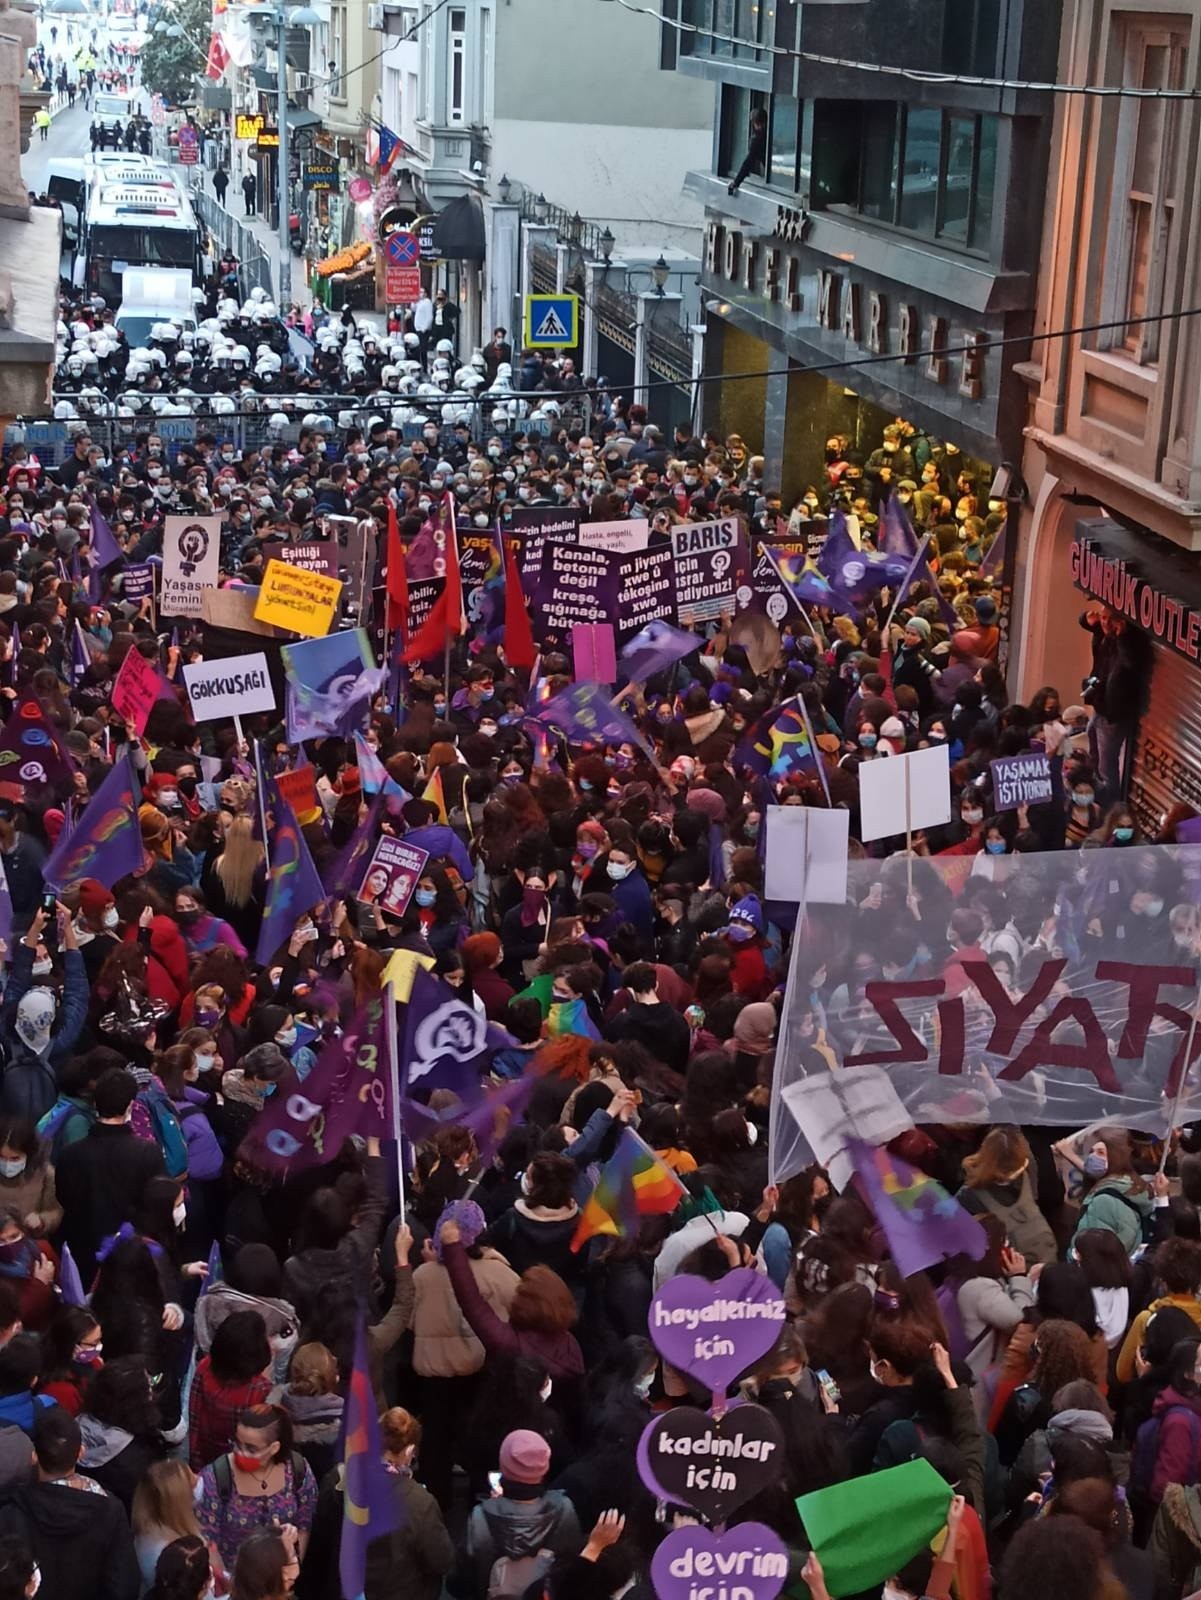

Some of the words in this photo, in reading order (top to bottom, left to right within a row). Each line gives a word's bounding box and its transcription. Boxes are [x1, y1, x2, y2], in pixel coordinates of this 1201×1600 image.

[705, 222, 804, 312] HOTEL
[541, 520, 575, 533] bedelini
[676, 522, 733, 554] BARIŞ
[281, 547, 320, 560] Eşitliği
[296, 560, 328, 570] sayan
[553, 547, 610, 565] Kanala,
[635, 551, 671, 573] jiyana
[553, 560, 607, 576] betona
[624, 572, 650, 587] xwe
[653, 565, 661, 578] û
[559, 573, 598, 588] değil
[617, 579, 670, 603] têkoşina
[676, 577, 732, 602] ediyoruz!
[553, 588, 600, 605] kreşe,
[632, 597, 657, 613] xwe
[1070, 537, 1139, 620] GÜMRÜK
[1140, 585, 1201, 660] OUTLE
[542, 603, 607, 619] sığınağa
[619, 605, 672, 631] bernadin
[190, 670, 267, 701] GÖKKUŞAĞI
[994, 758, 1051, 780] YAŞAMAK
[998, 778, 1053, 804] İSTİYORUM
[655, 1297, 786, 1329] hayalleriniz
[694, 1334, 735, 1360] için
[658, 1431, 776, 1462] kadınlar
[686, 1464, 737, 1490] için
[669, 1546, 788, 1579] devrim
